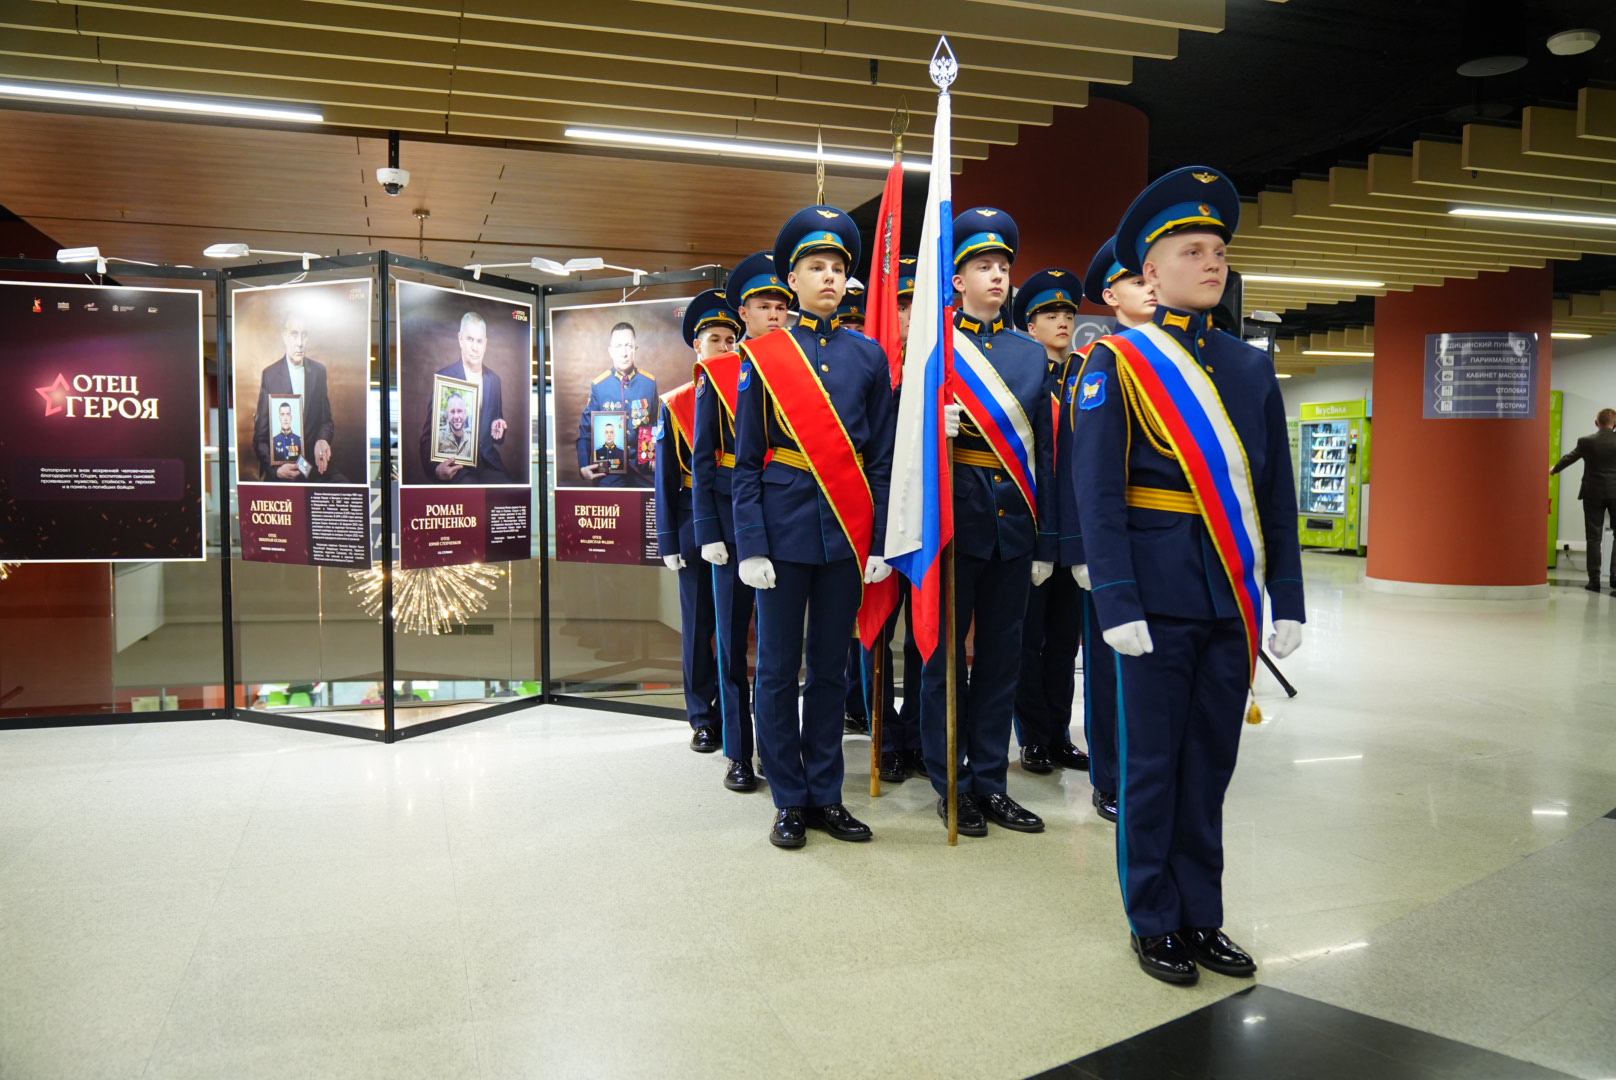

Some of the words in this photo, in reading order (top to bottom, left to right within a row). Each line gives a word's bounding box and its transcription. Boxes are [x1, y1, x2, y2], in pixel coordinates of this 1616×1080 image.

[73, 374, 139, 396] ОТЕЦ
[65, 396, 159, 419] ГЕРОЯ
[250, 499, 292, 512] АЛЕКСЕЙ
[426, 504, 463, 516] РОМАН
[574, 504, 620, 517] ЕВГЕНИЙ
[251, 512, 292, 525] ОСОКИН
[411, 516, 477, 530] СТЕПЧЕНКОВ
[578, 517, 616, 530] ФАДИН
